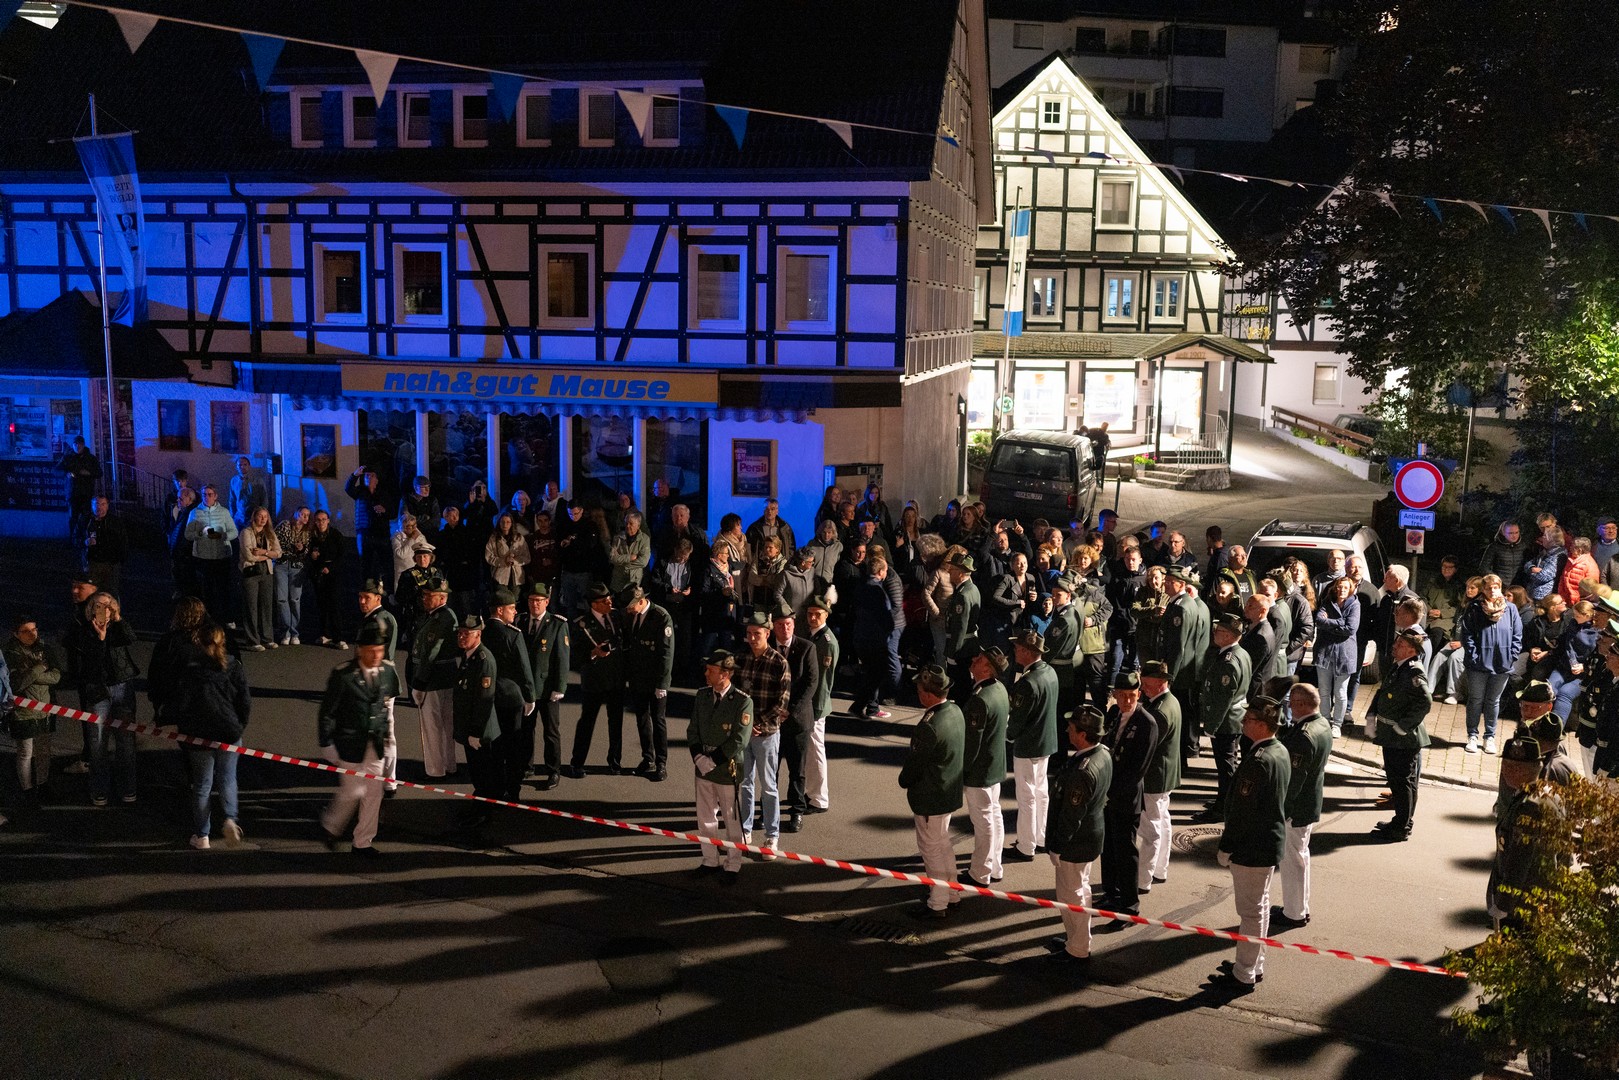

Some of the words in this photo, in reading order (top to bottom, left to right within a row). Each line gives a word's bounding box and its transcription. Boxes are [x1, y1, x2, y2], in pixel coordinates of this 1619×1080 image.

[383, 369, 539, 398] nah&gut
[548, 374, 671, 399] Mause
[739, 462, 767, 473] Persil
[1403, 513, 1431, 521] Anlieger
